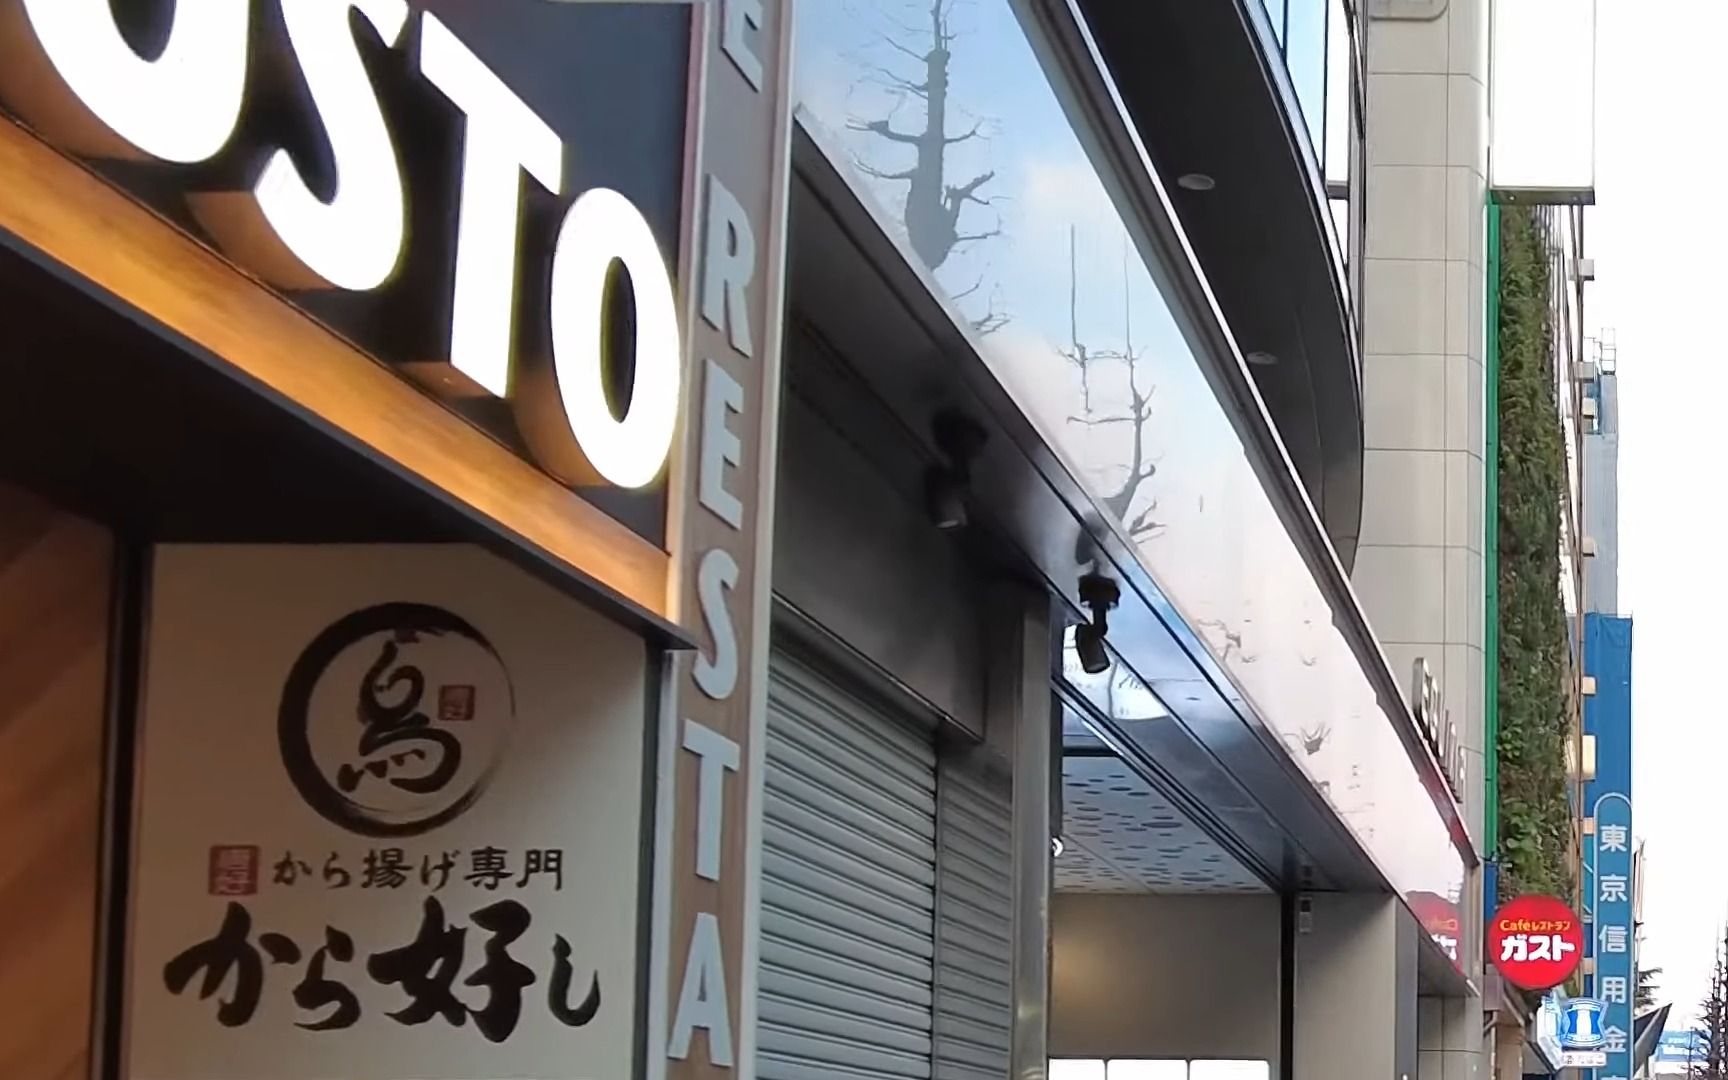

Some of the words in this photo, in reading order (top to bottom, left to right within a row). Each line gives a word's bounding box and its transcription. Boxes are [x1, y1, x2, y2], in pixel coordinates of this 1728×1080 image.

[271, 846, 564, 892] から揚げ専門
[163, 894, 602, 1043] から好し
[1501, 934, 1576, 962] ガスト
